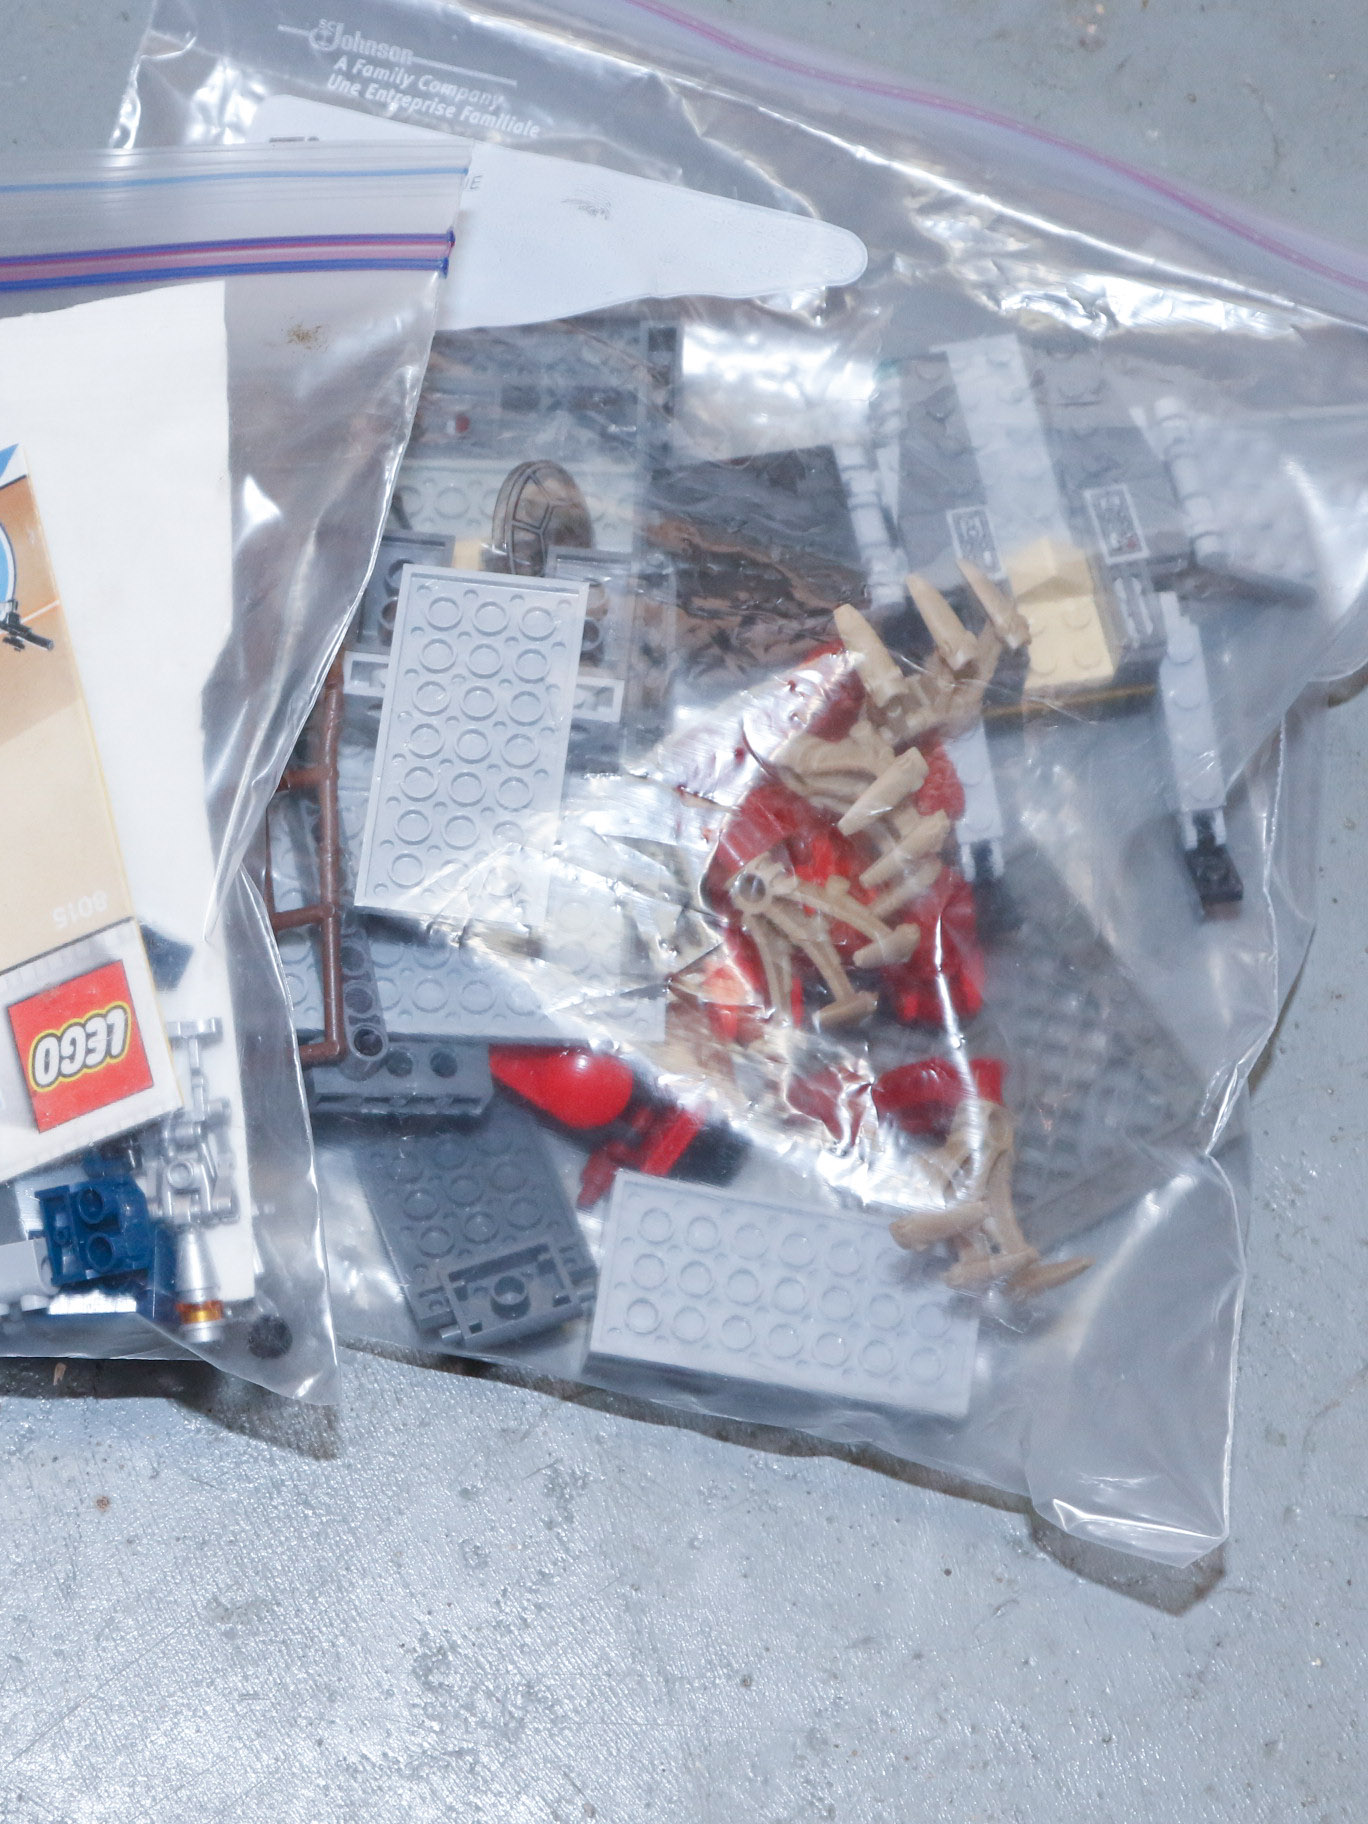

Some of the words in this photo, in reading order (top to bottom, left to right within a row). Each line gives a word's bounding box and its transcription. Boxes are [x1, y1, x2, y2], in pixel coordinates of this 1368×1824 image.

[309, 23, 414, 65] Johnson
[327, 73, 361, 97] Une
[365, 84, 457, 118] Entreprise
[460, 105, 541, 138] Familiale
[334, 55, 348, 71] A
[352, 59, 415, 89] Family
[418, 75, 504, 111] Company
[51, 890, 109, 931] 8015
[31, 1002, 131, 1091] LEGO
